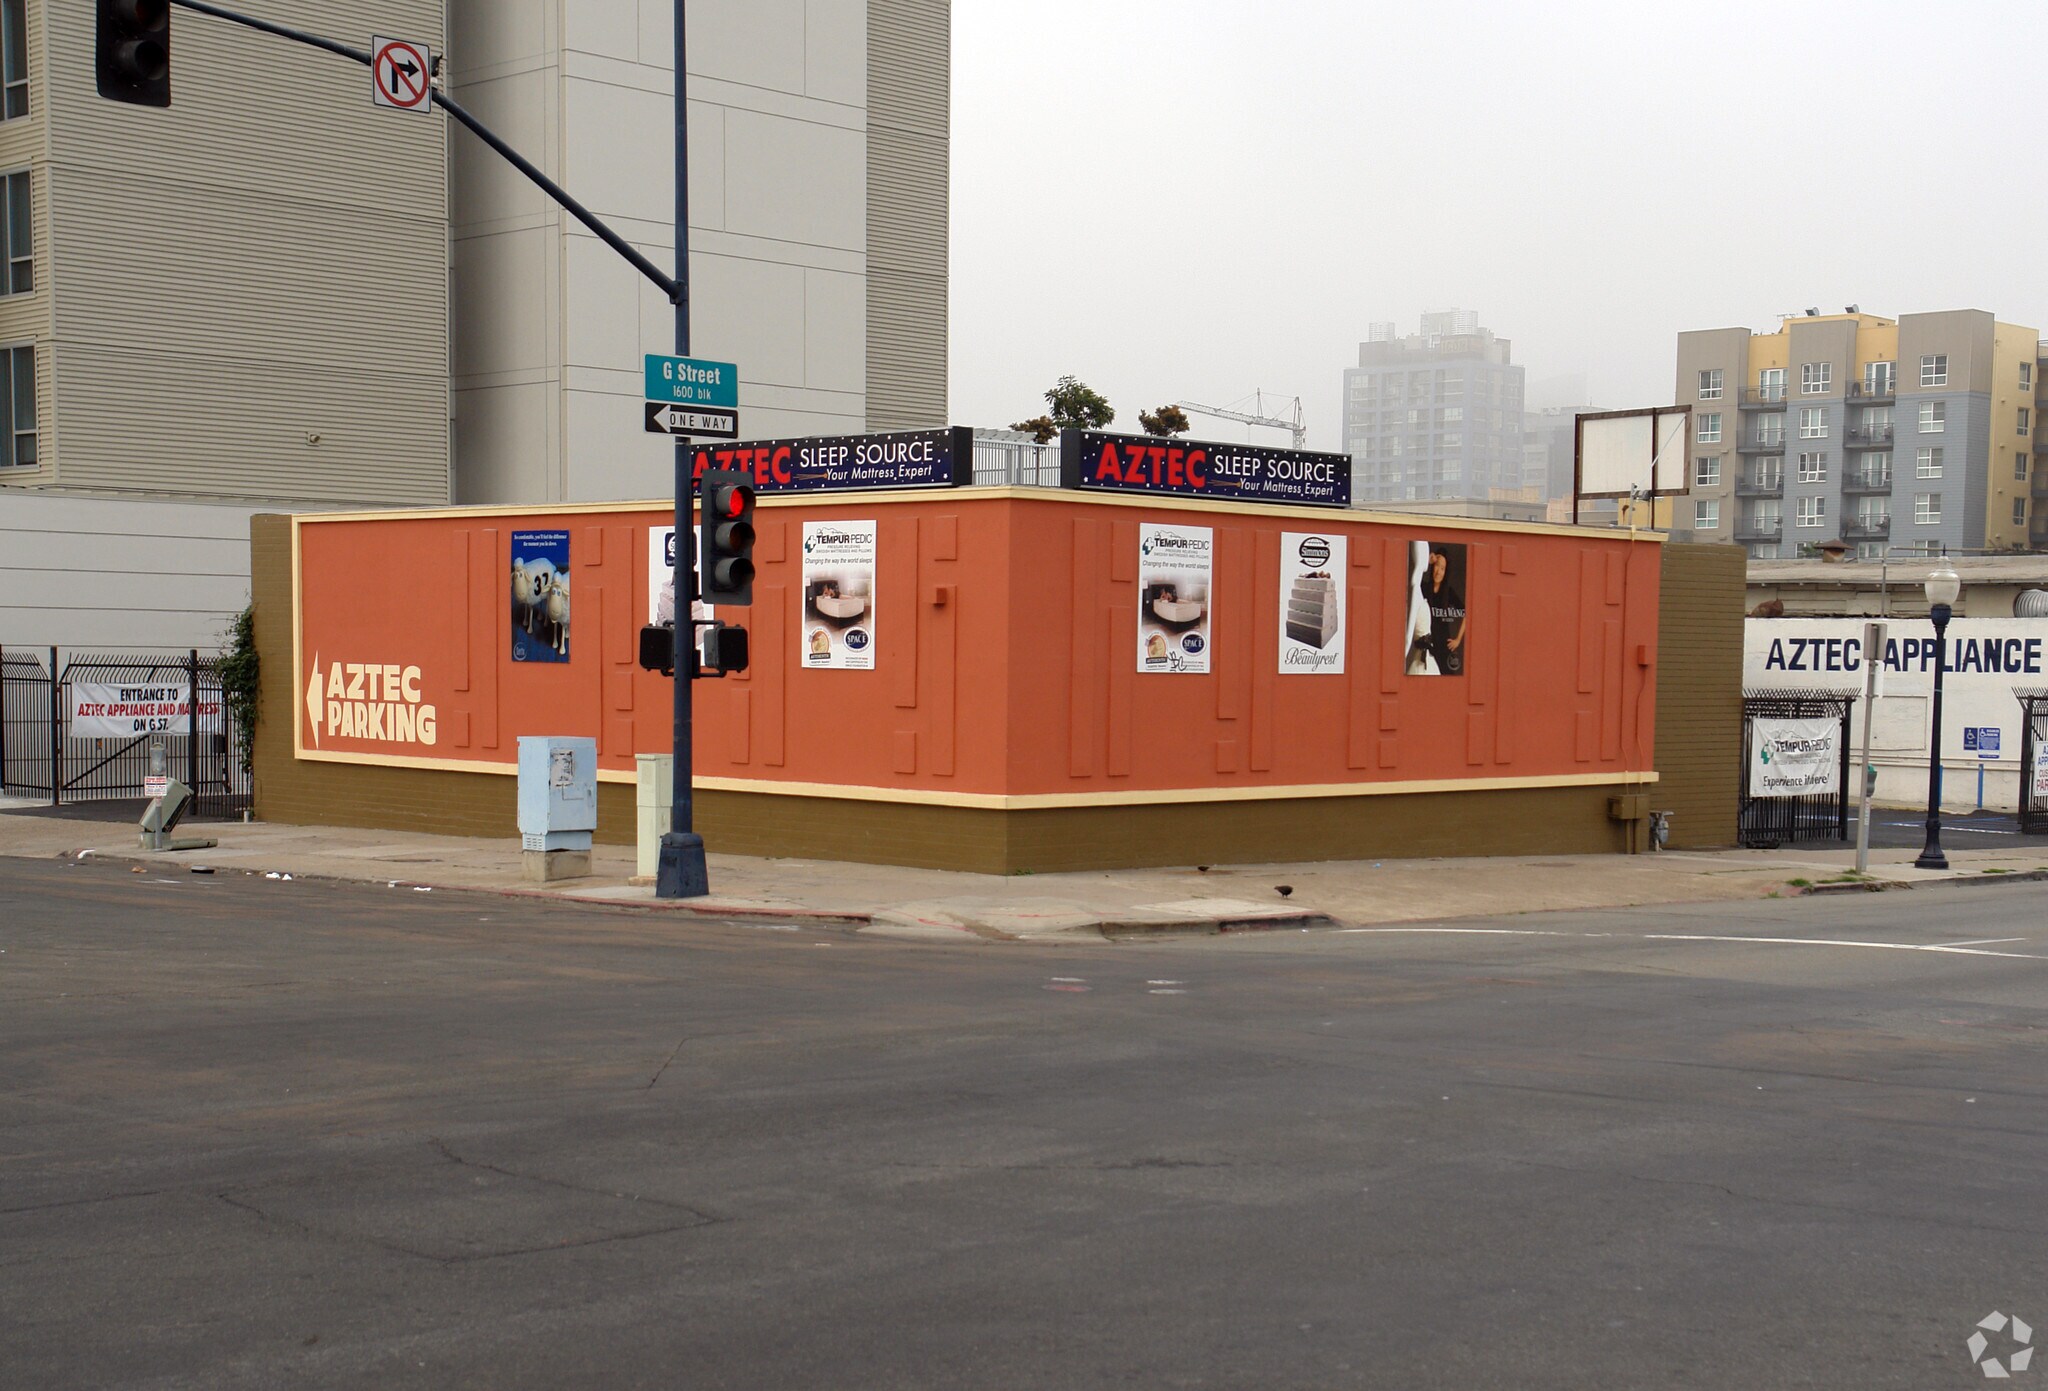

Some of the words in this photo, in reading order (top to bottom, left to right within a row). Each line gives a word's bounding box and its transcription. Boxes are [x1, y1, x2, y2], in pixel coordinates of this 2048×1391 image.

[663, 361, 673, 380] G
[677, 363, 721, 385] Street
[673, 385, 693, 399] 1600
[698, 388, 712, 400] blk
[670, 413, 695, 427] ONE
[702, 416, 727, 430] WAY
[799, 446, 849, 468] SLEEP
[855, 441, 933, 465] SOURCE
[826, 468, 848, 481] Your
[851, 466, 894, 480] Mattress
[898, 464, 932, 479] Expert
[1095, 442, 1207, 488] AZTEC
[1214, 454, 1261, 477] SLEEP
[1267, 458, 1335, 483] SOURCE
[1239, 478, 1260, 491] Your
[1263, 479, 1302, 494] Mattress
[1305, 481, 1333, 498] Expert
[1301, 547, 1329, 557] Simmons
[1431, 606, 1447, 617] VERA
[1447, 607, 1465, 617] WANG
[847, 635, 866, 643] SPACE
[1183, 639, 1202, 648] SPACE
[1284, 647, 1339, 672] Beautyrest
[1765, 638, 1861, 671] AZTEC
[1883, 638, 2042, 673] APPLIANCE
[326, 662, 421, 703] AZTEC
[120, 689, 165, 701] ENTRANCE
[167, 688, 178, 700] TO
[78, 703, 105, 716] AZTEC
[107, 703, 155, 716] APPLIANCE
[157, 703, 176, 716] AND
[133, 718, 146, 731] ON
[149, 718, 156, 731] G
[157, 718, 169, 731] ST.
[327, 700, 437, 745] PARKING
[1763, 775, 1803, 790] Experience
